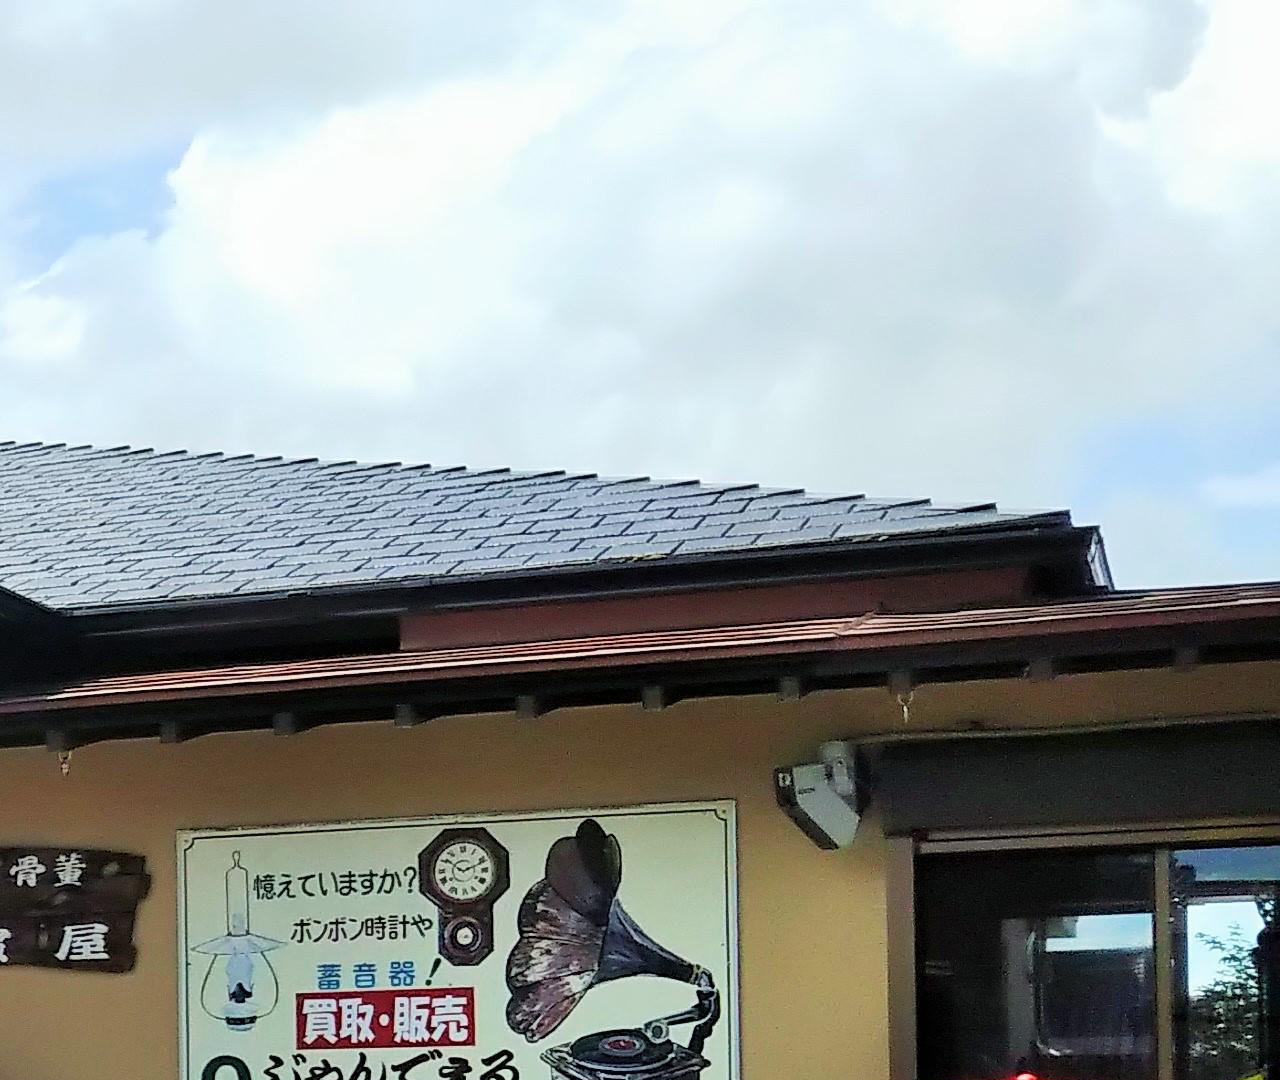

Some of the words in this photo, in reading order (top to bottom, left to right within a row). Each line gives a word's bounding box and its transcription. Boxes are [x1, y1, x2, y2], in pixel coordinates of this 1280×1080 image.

[9, 852, 88, 888] 骨董
[253, 867, 417, 900] 憶えていますか?
[290, 914, 433, 944] ボンボン時計や
[301, 994, 469, 1045] 買取・販売
